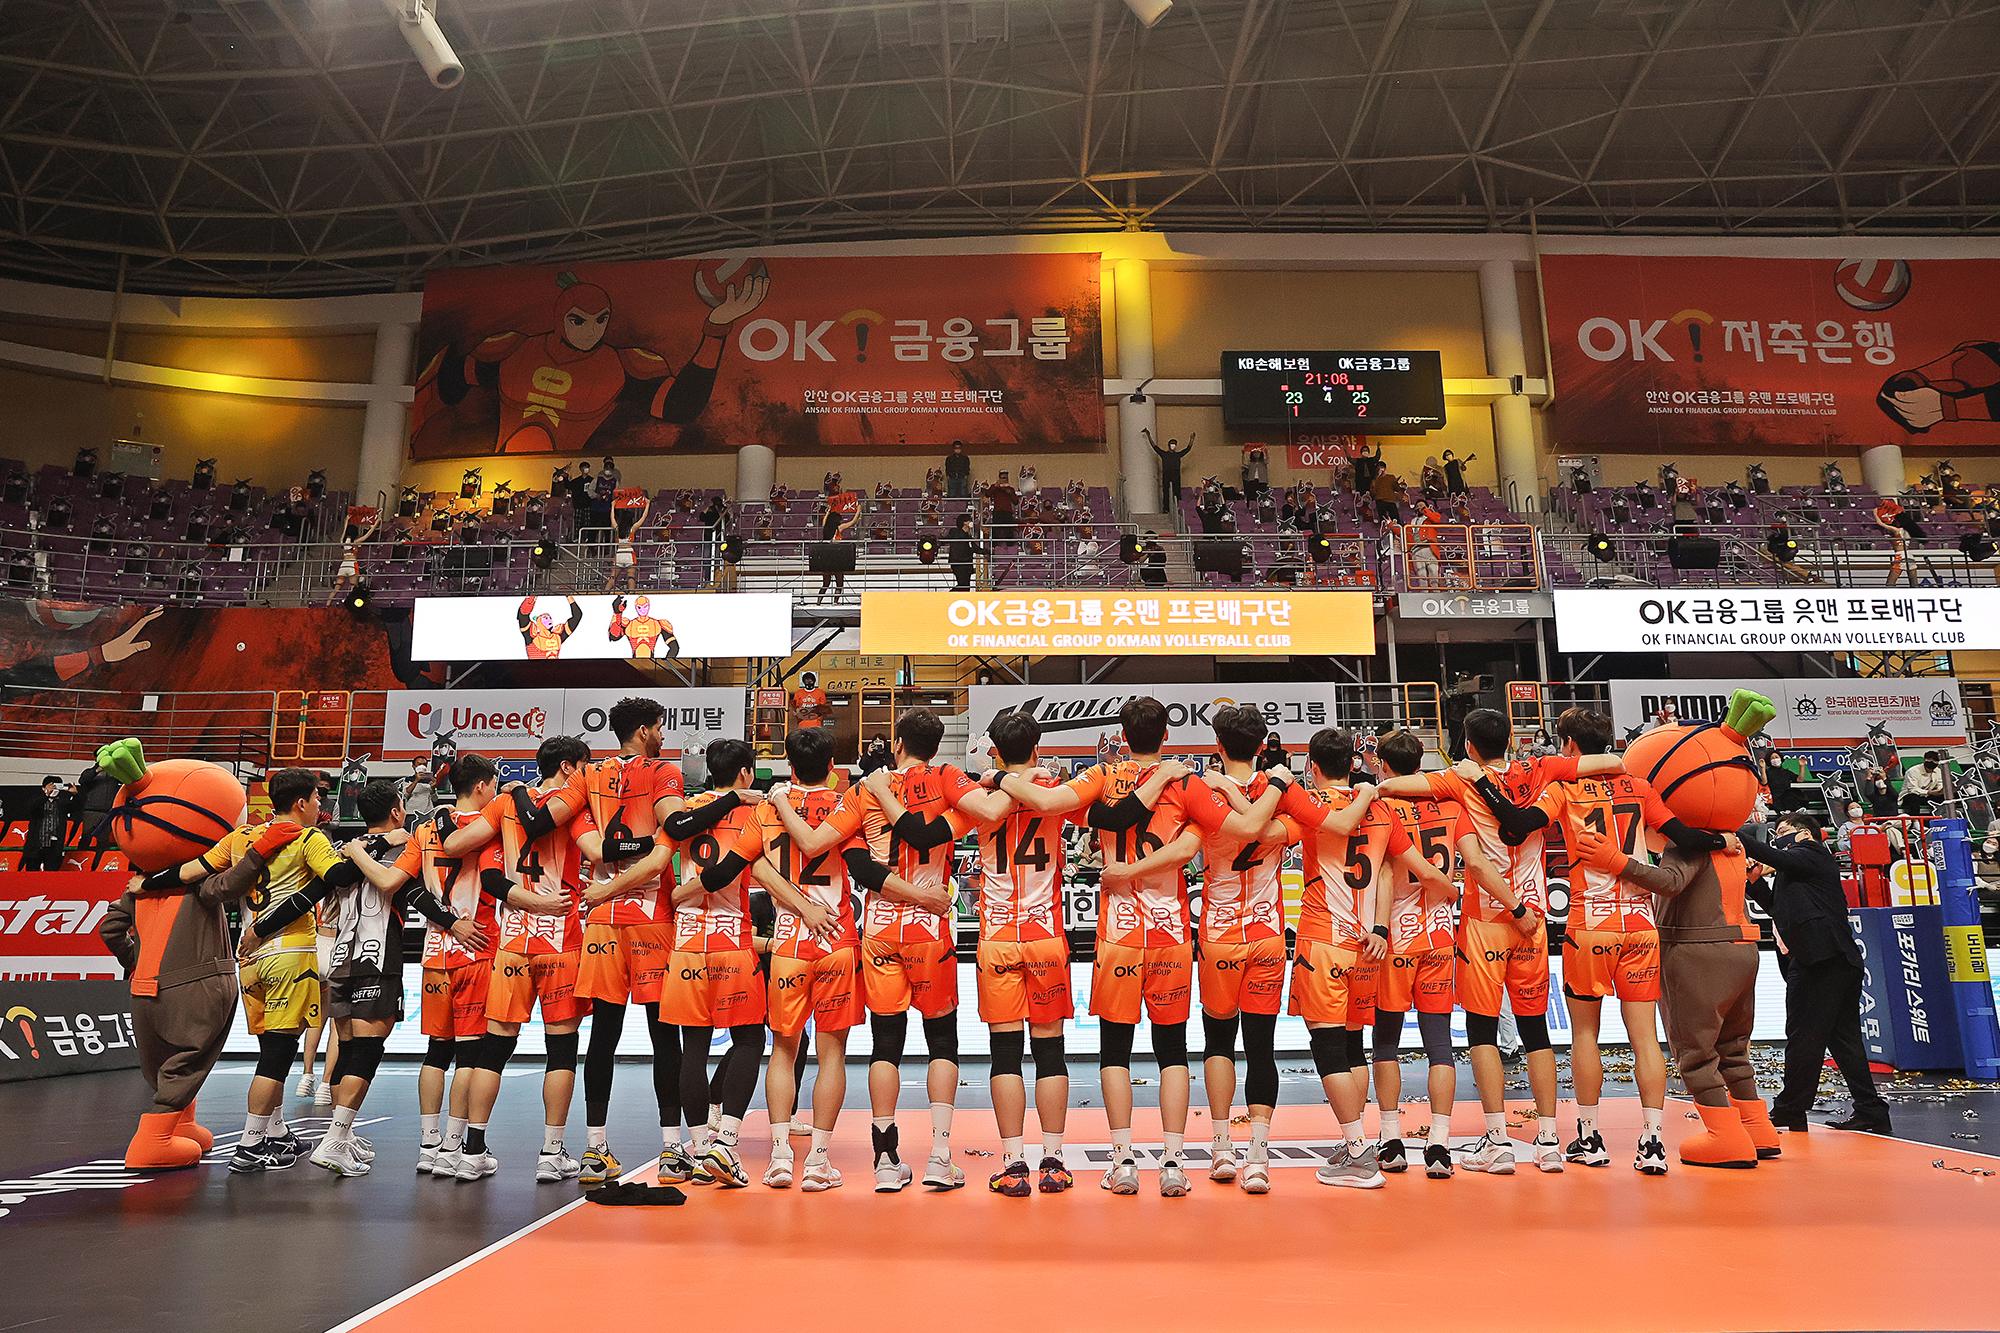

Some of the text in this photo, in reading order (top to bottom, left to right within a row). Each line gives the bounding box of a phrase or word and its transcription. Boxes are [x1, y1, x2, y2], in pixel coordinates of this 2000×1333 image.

[890, 317, 1070, 362] 금융그룹
[1722, 320, 1895, 365] 저축은행
[1238, 358, 1310, 371] KB손해보험
[1339, 358, 1411, 371] OK금융그룹
[1305, 373, 1349, 385] 21:08
[804, 390, 829, 403] 안산
[831, 390, 908, 403] OK금융그룹
[941, 391, 1003, 403] 프로배구단
[1285, 392, 1370, 404] 23 4 25
[1646, 391, 1669, 403] 안산
[1672, 391, 1744, 404] OK금융그룹
[1775, 392, 1834, 405] 프로배구단
[1293, 405, 1367, 416] 1 2
[1776, 407, 1817, 415] VOLLEYBALL
[1819, 407, 1836, 415] CLUB
[1301, 452, 1350, 465] OK ZON
[948, 599, 1291, 626] OK금융그룹 읏맨 프로배구단
[1471, 599, 1529, 615] 금융그룹
[1640, 598, 1962, 624] OK금융그룹 읏맨 프로배구단
[948, 634, 1291, 648] OK FINANCIAL GROUP OKMAN VOLLEYBALL CLUB
[1642, 633, 1965, 645] OK FINANCIAL GROUP OKMAN VOLLEYBALL CLUB
[827, 681, 858, 691] GATE
[1039, 695, 1138, 721] KOLC
[1825, 696, 1921, 709] 한국해양콘텐츠개발
[1240, 702, 1326, 726] 융그룹
[1584, 780, 1633, 797] 박창성
[605, 805, 633, 839] 6
[1584, 804, 1641, 855] 17
[989, 818, 1050, 875] 14
[517, 836, 545, 882] 4
[771, 832, 831, 886] 12
[1343, 834, 1371, 890] 5
[434, 857, 463, 907] 7
[1148, 961, 1182, 969] FINANCIAL
[1247, 981, 1265, 991] ONE
[1420, 982, 1436, 990] ONE
[1897, 931, 1931, 1044] 포카리 스웨트
[1168, 989, 1188, 1001] TEAM
[309, 1003, 319, 1018] 3
[43, 1013, 138, 1057] 금융그
